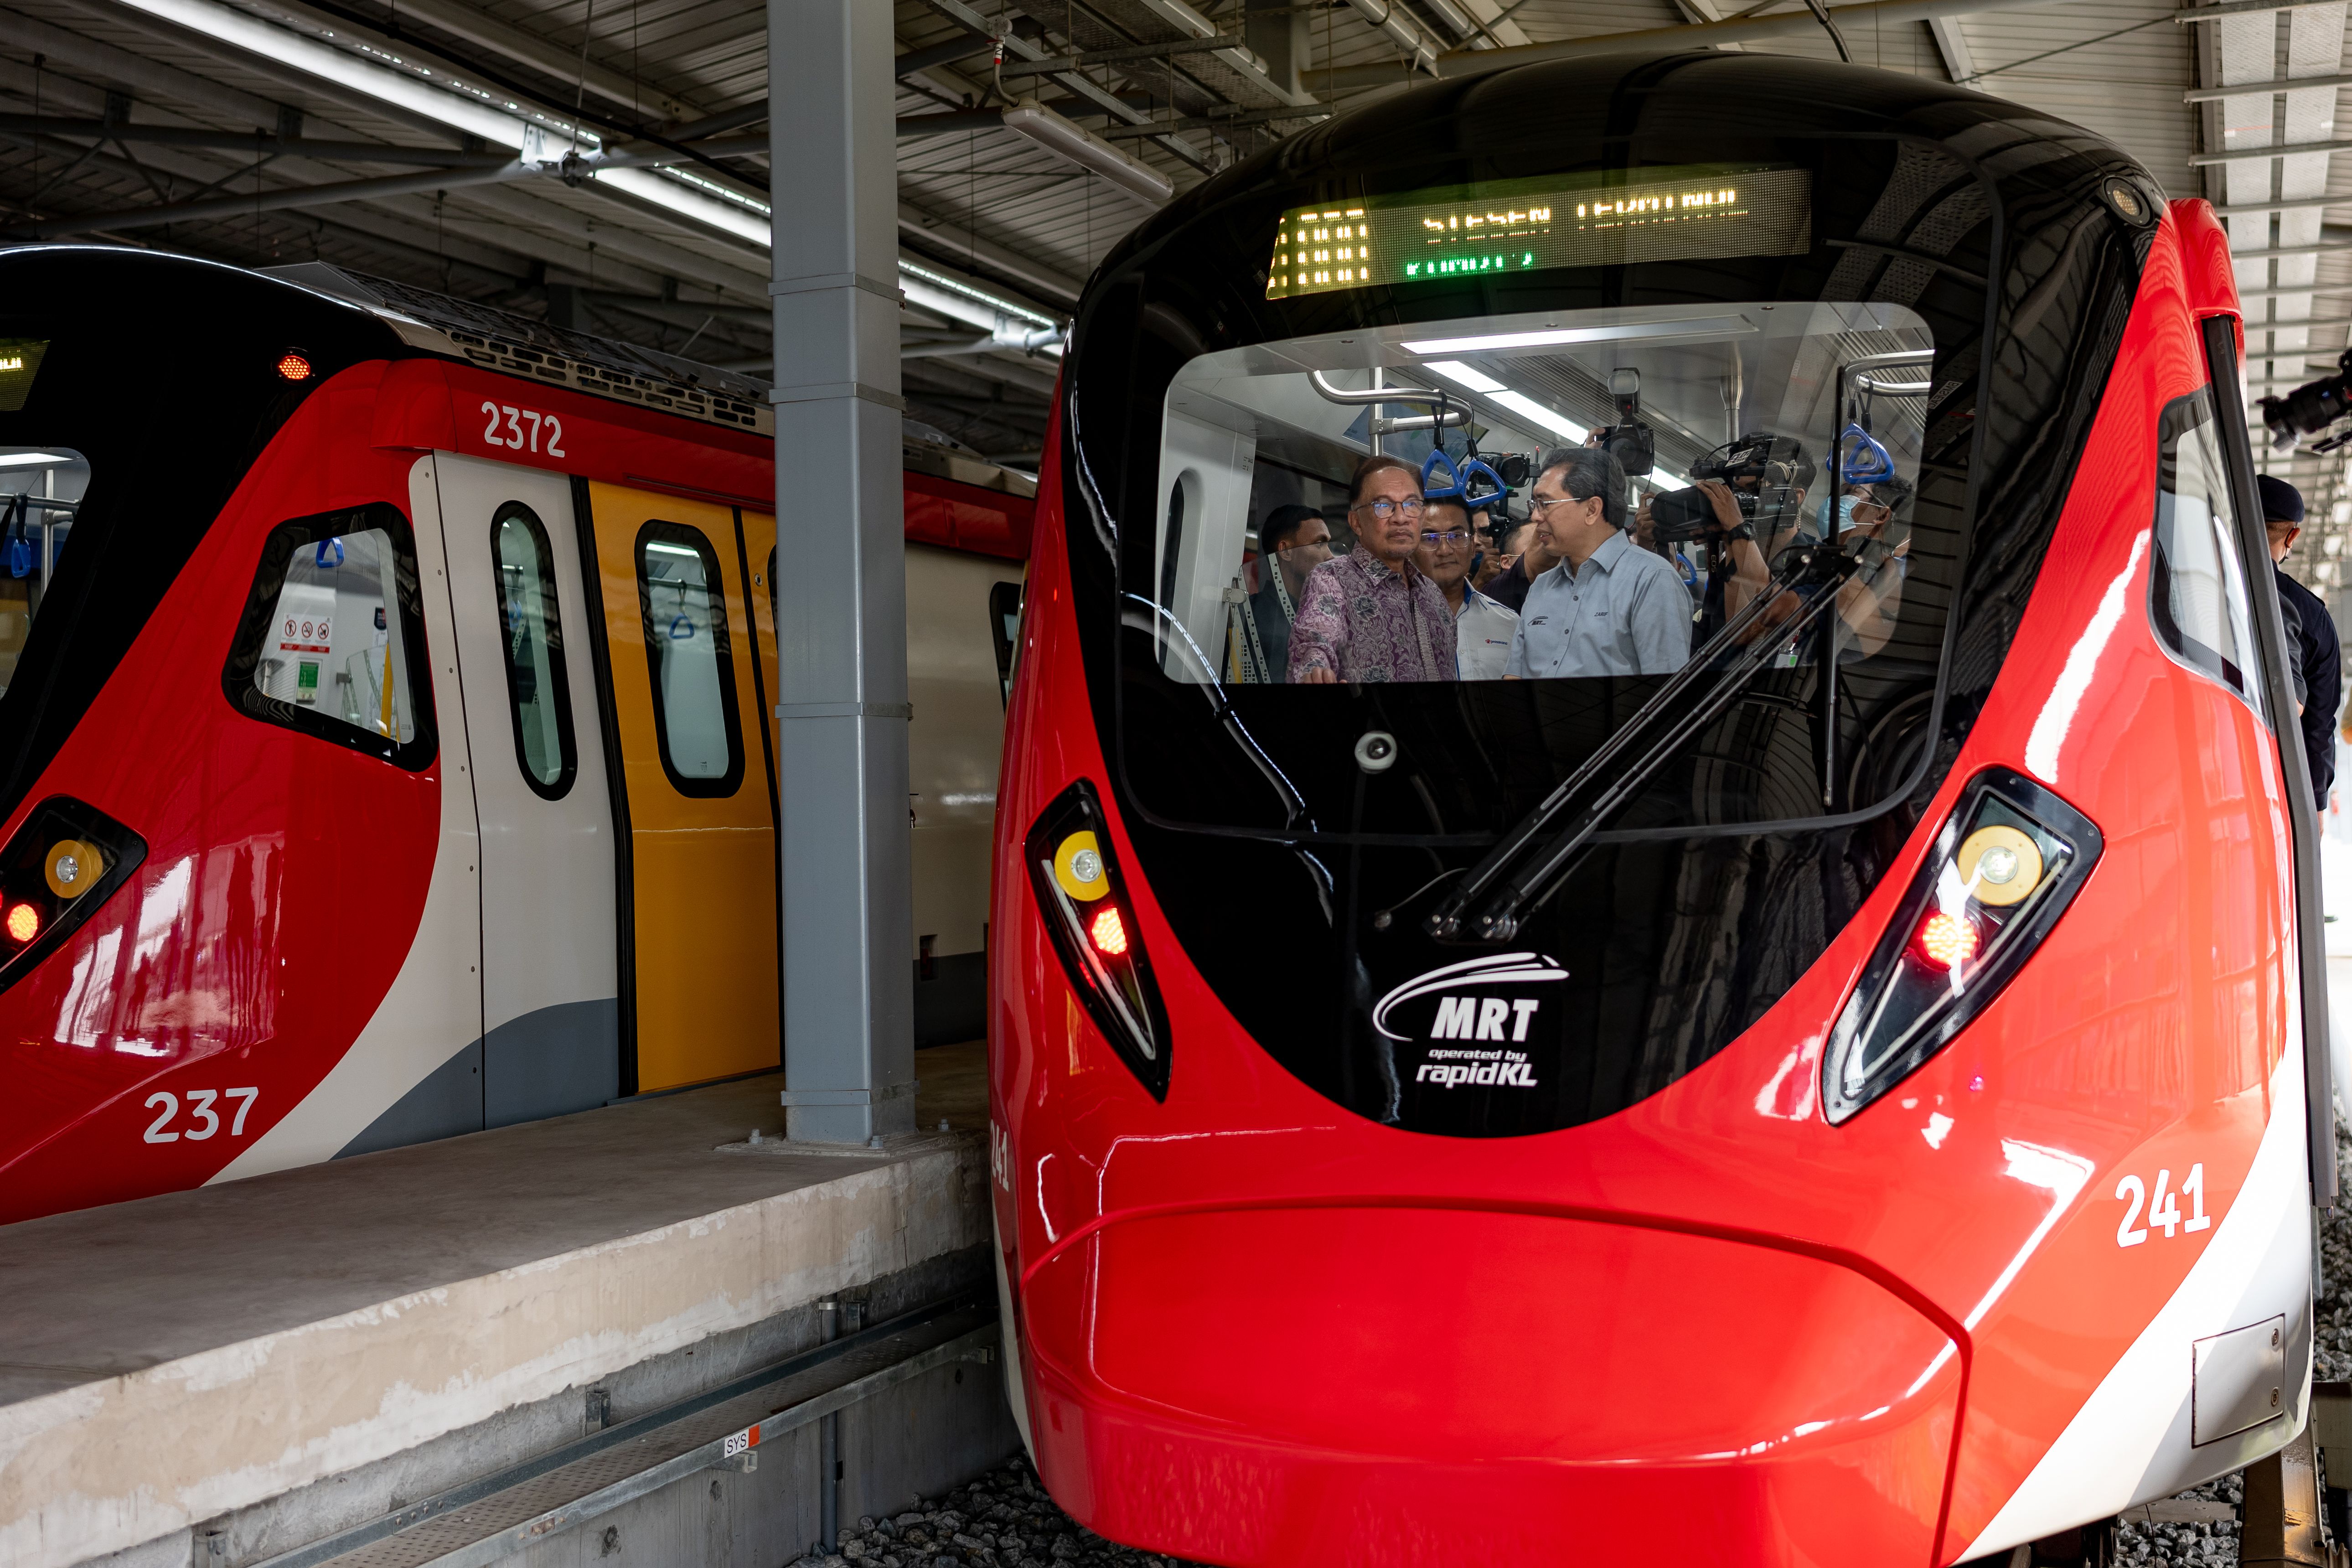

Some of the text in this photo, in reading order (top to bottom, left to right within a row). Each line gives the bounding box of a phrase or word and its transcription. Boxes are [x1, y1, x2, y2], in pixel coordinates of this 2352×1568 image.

[481, 401, 565, 458] 2372
[1430, 997, 1539, 1041] MRT
[1416, 1062, 1538, 1089] rapidKL
[1428, 1049, 1527, 1063] operated by
[143, 1087, 259, 1144] 237
[2115, 1163, 2211, 1248] 241
[727, 1433, 747, 1454] SYS
